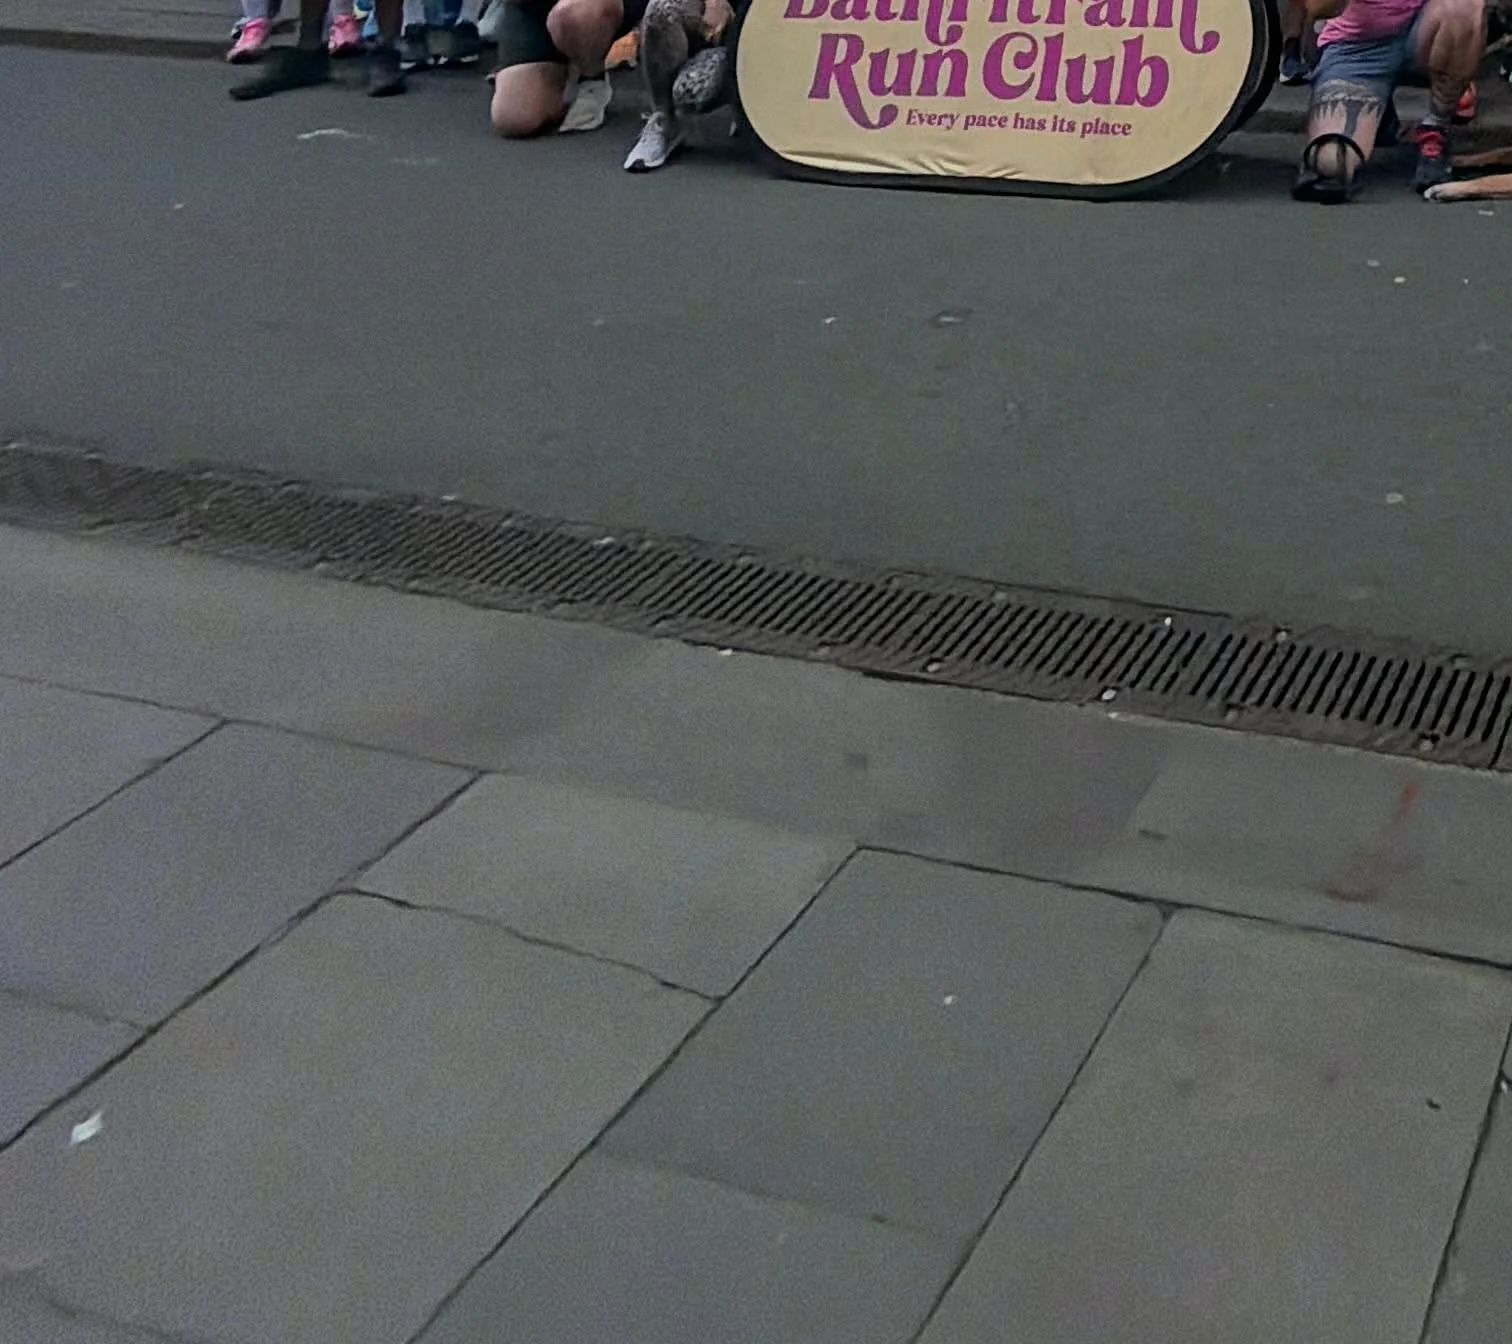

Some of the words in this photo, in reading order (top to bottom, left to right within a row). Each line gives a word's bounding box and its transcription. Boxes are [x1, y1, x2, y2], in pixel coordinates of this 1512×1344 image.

[807, 32, 969, 130] Run
[982, 31, 1170, 108] Club
[905, 108, 960, 131] Every
[963, 113, 1009, 131] pace
[1012, 112, 1047, 131] has
[1050, 115, 1076, 134] its
[1079, 117, 1133, 139] place
